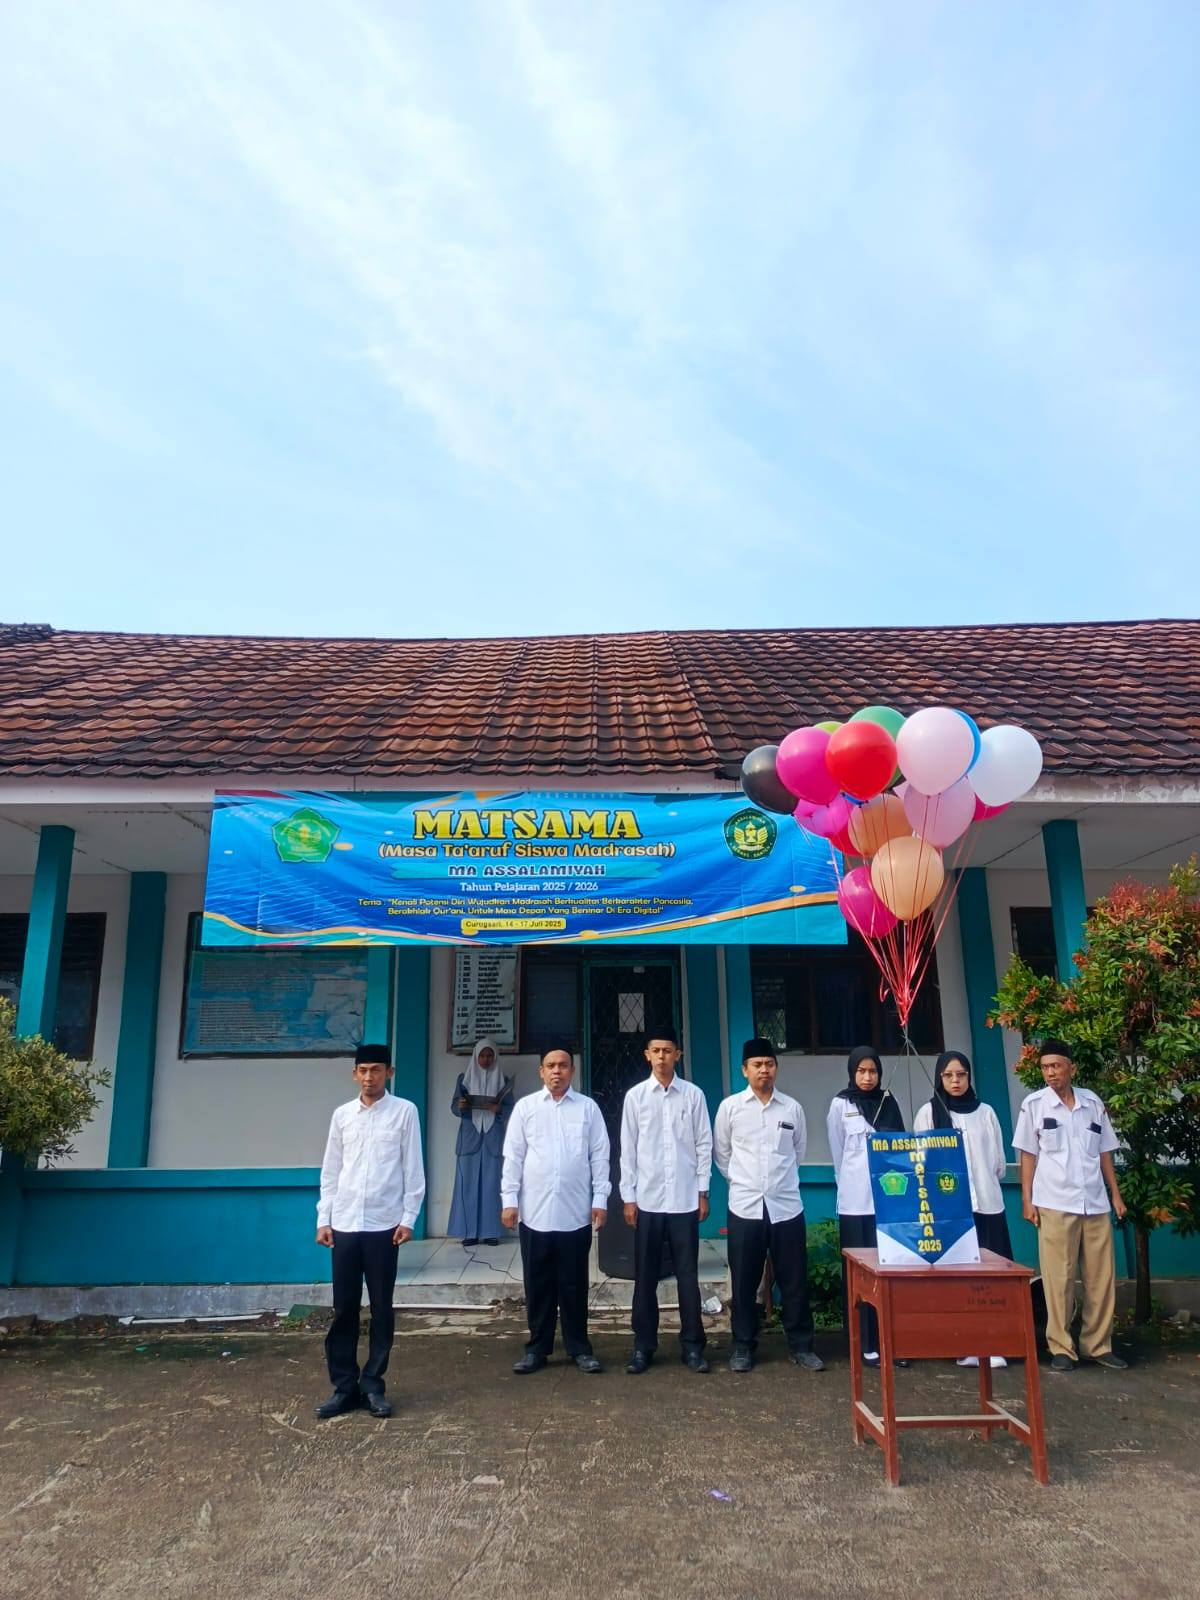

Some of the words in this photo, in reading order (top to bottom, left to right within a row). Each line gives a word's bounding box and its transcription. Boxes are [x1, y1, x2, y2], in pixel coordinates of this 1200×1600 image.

[412, 808, 643, 840] MATSAMA
[379, 842, 438, 858] (Masa
[442, 842, 512, 858] Ta'aruf
[515, 843, 568, 857] Siswa
[573, 842, 676, 858] Madrasah)
[448, 864, 477, 877] MA
[483, 864, 606, 877] ASSALAMIYAH
[460, 882, 492, 892] Tahun
[494, 882, 540, 893] Pelajaran
[542, 881, 566, 891] 2025
[574, 881, 599, 891] 2026
[358, 898, 382, 906] Tema
[419, 898, 449, 906] Potensi
[467, 898, 510, 906] Wujudkan
[512, 897, 552, 905] Madrasah
[554, 897, 600, 905] Berkualitas
[602, 897, 651, 905] Berkarakter
[519, 906, 546, 915] Depan
[548, 906, 569, 915] Yang
[571, 906, 604, 914] Bersinar
[606, 906, 615, 914] Di
[617, 906, 632, 914] Era
[505, 920, 513, 928] 14
[520, 920, 528, 928] 17
[530, 920, 543, 928] Juli
[544, 920, 562, 928] 2025
[872, 1139, 889, 1151] MA
[891, 1136, 958, 1151] ASSALAMIYAH
[909, 1151, 935, 1237] MATSAMA
[917, 1240, 943, 1252] 2025
